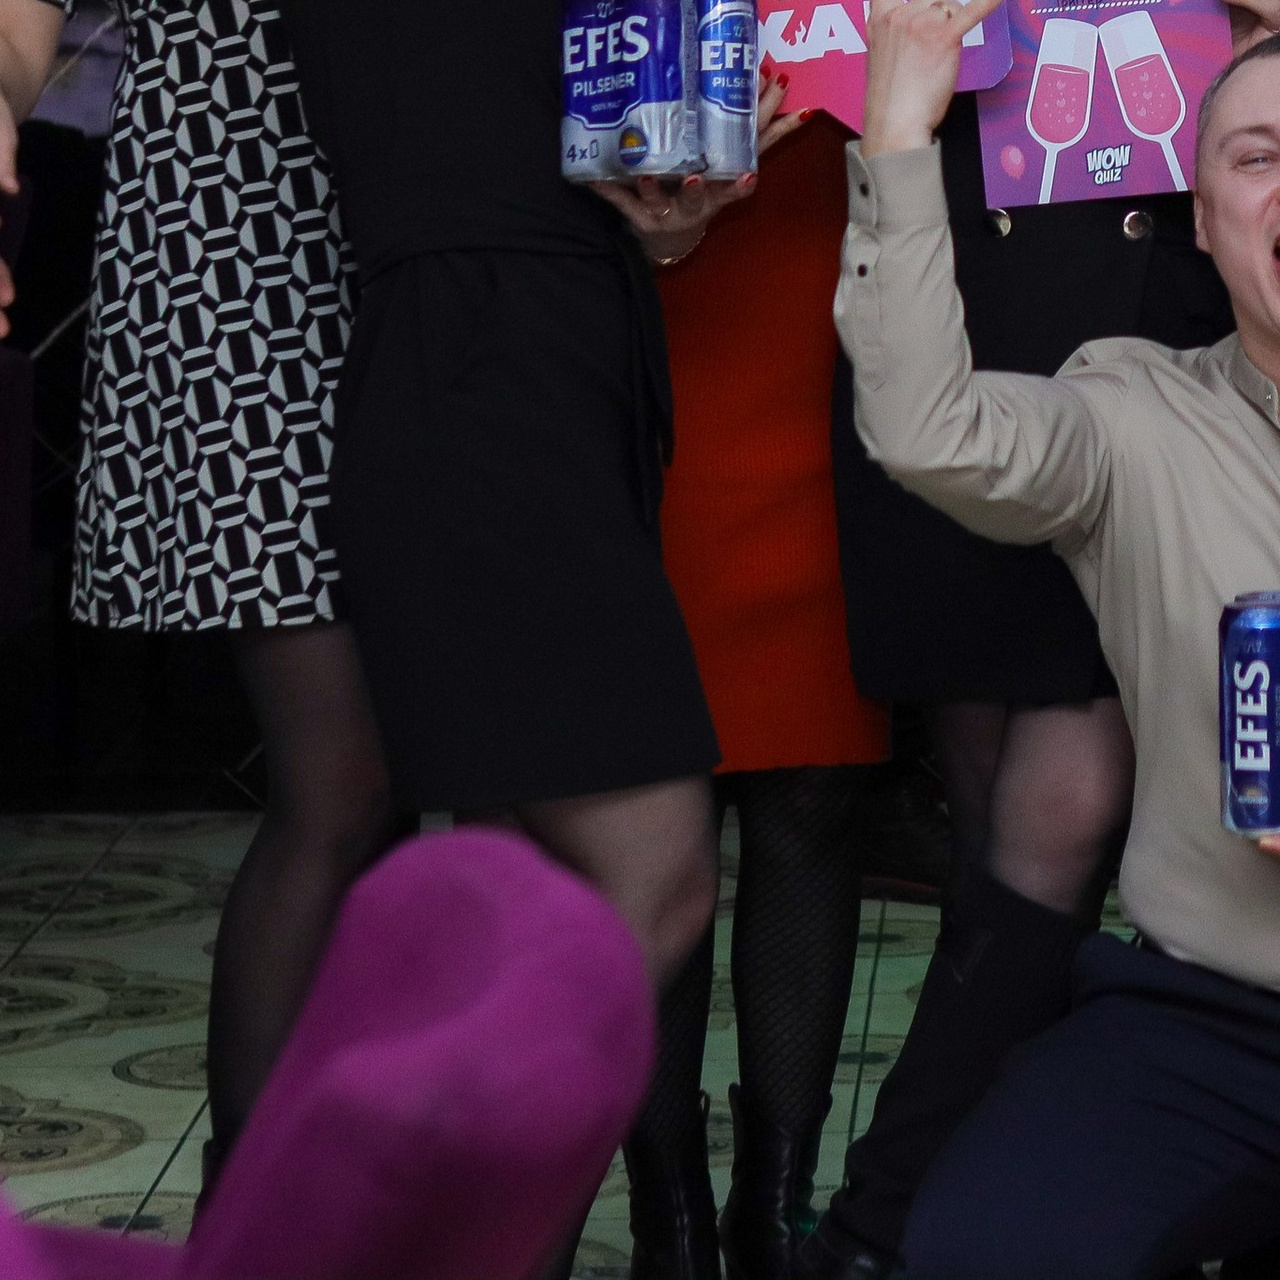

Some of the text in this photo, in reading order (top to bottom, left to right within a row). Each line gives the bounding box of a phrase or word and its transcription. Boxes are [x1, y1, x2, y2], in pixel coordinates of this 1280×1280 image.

[563, 15, 650, 74] EFES
[701, 40, 754, 71] EFE
[572, 71, 636, 98] PILSENER
[1086, 144, 1131, 173] WOW
[1094, 167, 1122, 185] QUIZ
[1233, 659, 1271, 771] EFES
